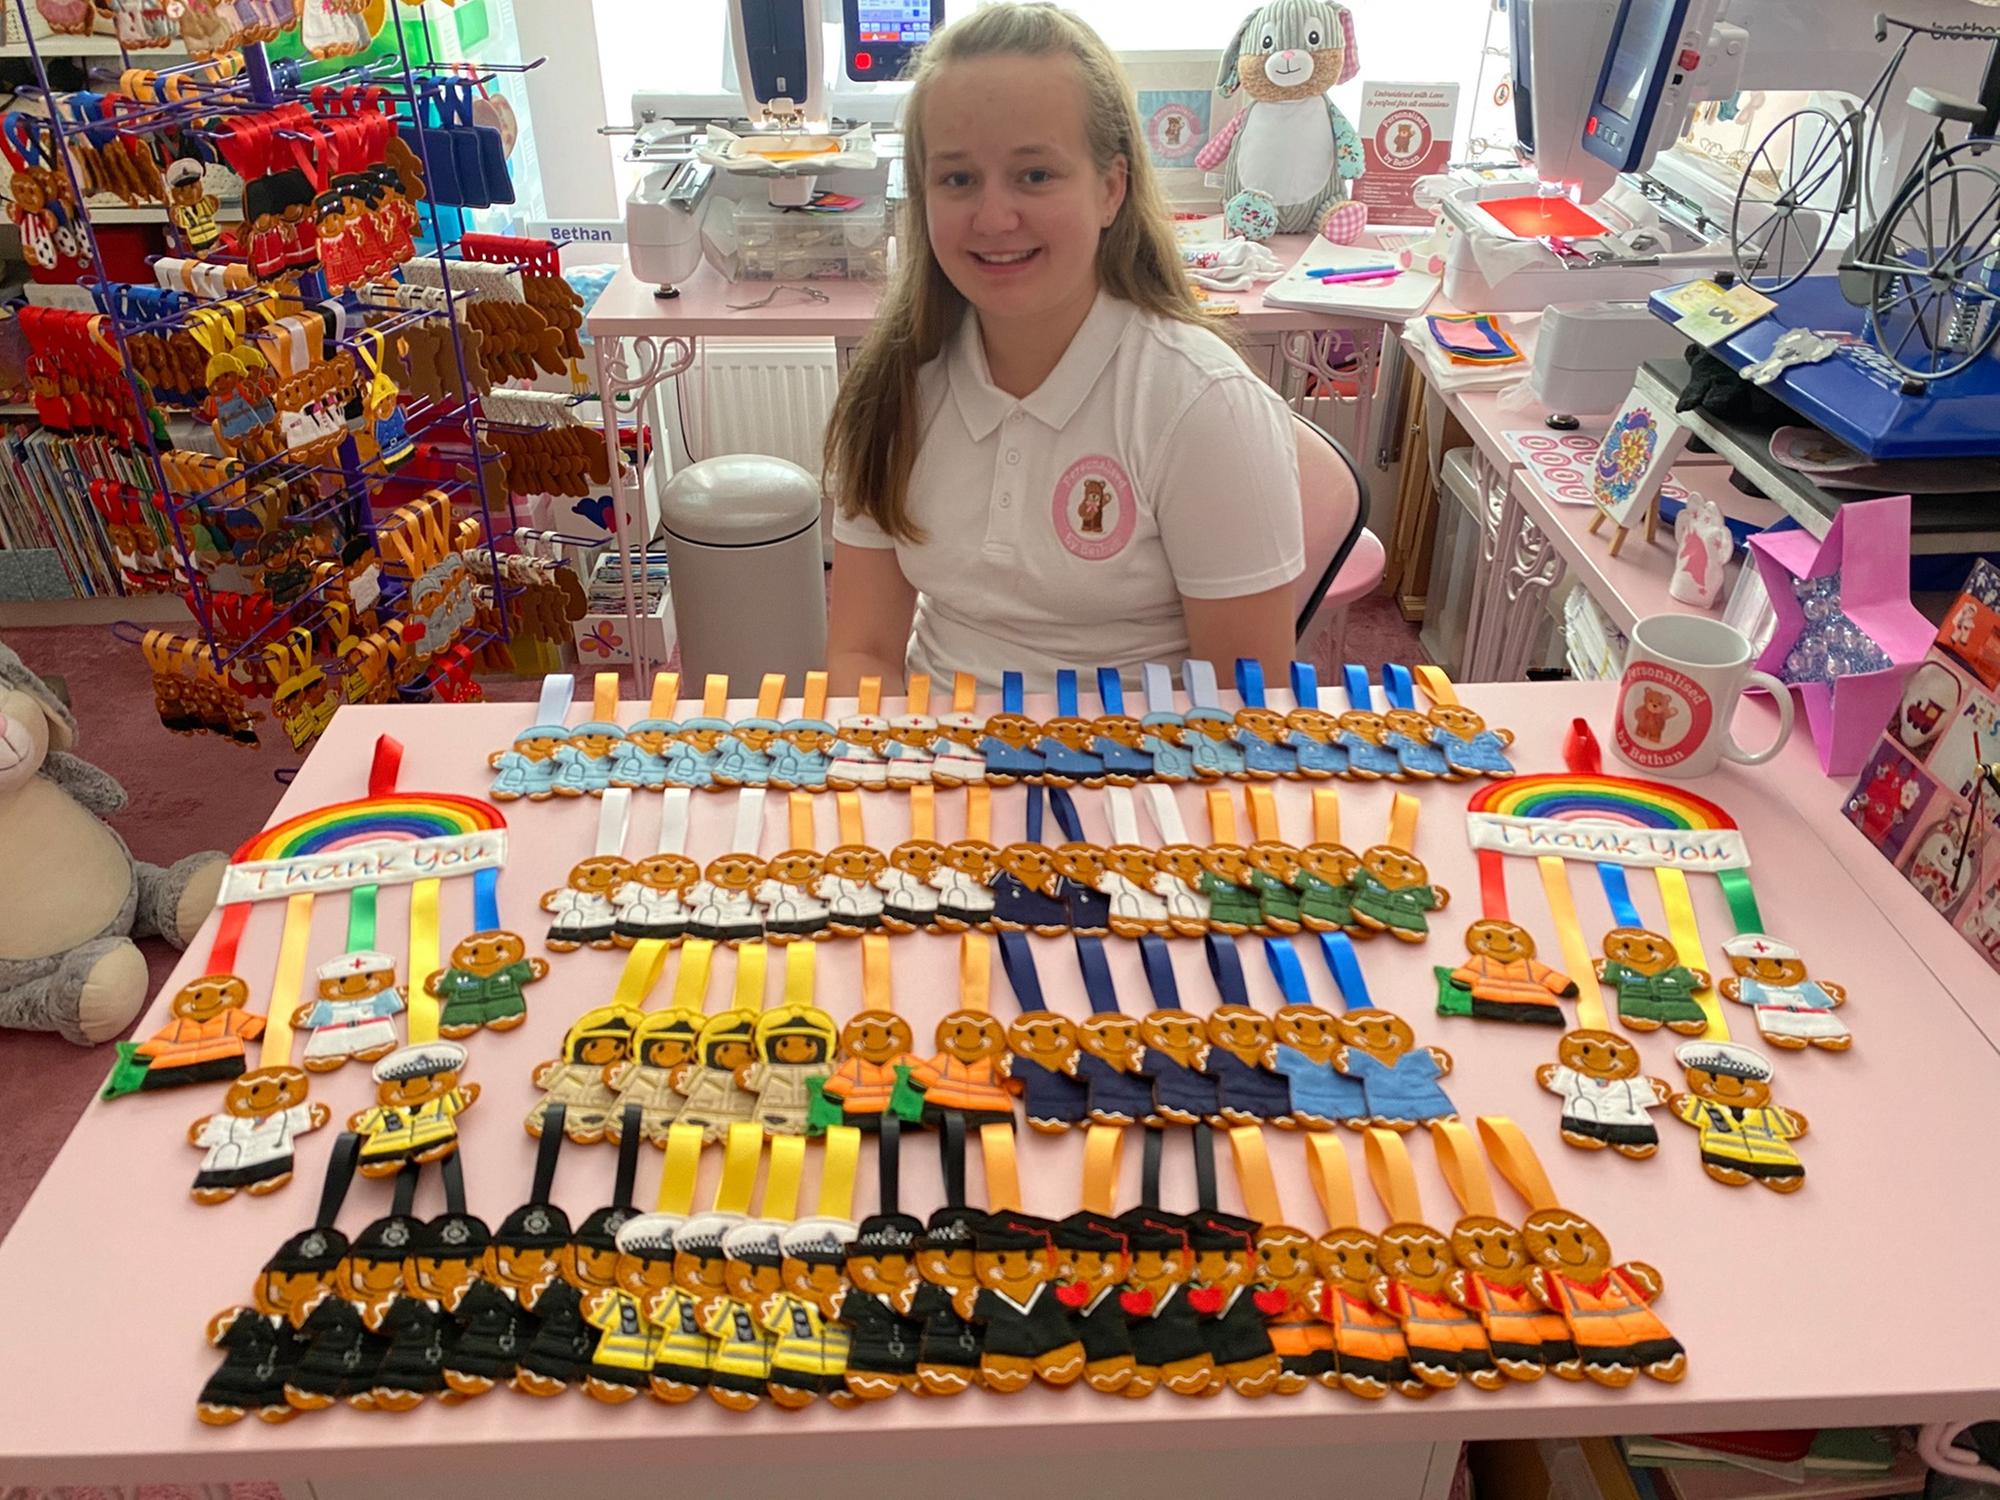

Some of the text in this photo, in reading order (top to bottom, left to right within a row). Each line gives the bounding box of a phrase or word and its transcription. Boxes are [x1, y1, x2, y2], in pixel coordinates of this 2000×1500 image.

[551, 227, 612, 241] Bethan
[1626, 666, 1708, 705] Personalised
[1629, 747, 1685, 766] Bethan
[1487, 820, 1732, 861] Thank You
[252, 846, 491, 890] Thank You
